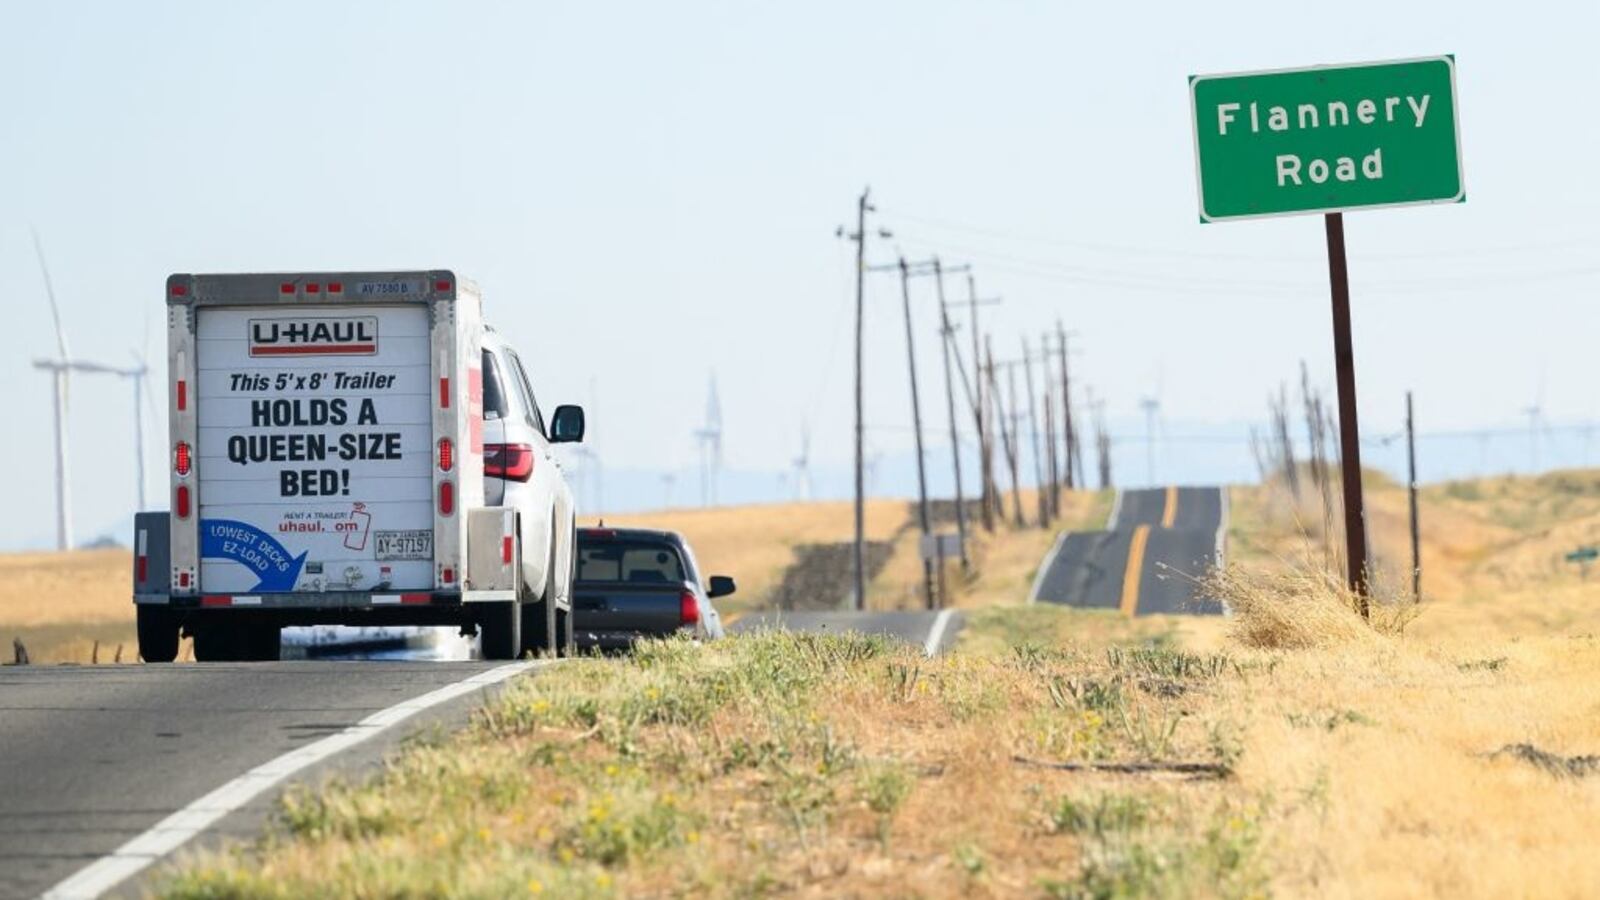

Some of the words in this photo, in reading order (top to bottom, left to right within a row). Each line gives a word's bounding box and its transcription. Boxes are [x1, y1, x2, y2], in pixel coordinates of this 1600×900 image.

[1217, 94, 1431, 135] Flannery
[1276, 148, 1383, 187] Road
[253, 322, 373, 344] U-HAUL
[231, 373, 270, 392] This
[334, 371, 396, 390] Trailer
[251, 398, 348, 427] HOLDS
[357, 398, 378, 426] A
[227, 432, 402, 466] QUEEN-SIZE
[280, 469, 350, 497] BED!
[211, 525, 258, 545] LOWEST
[258, 540, 290, 572] DECKS
[222, 540, 269, 571] EZ-LOAD
